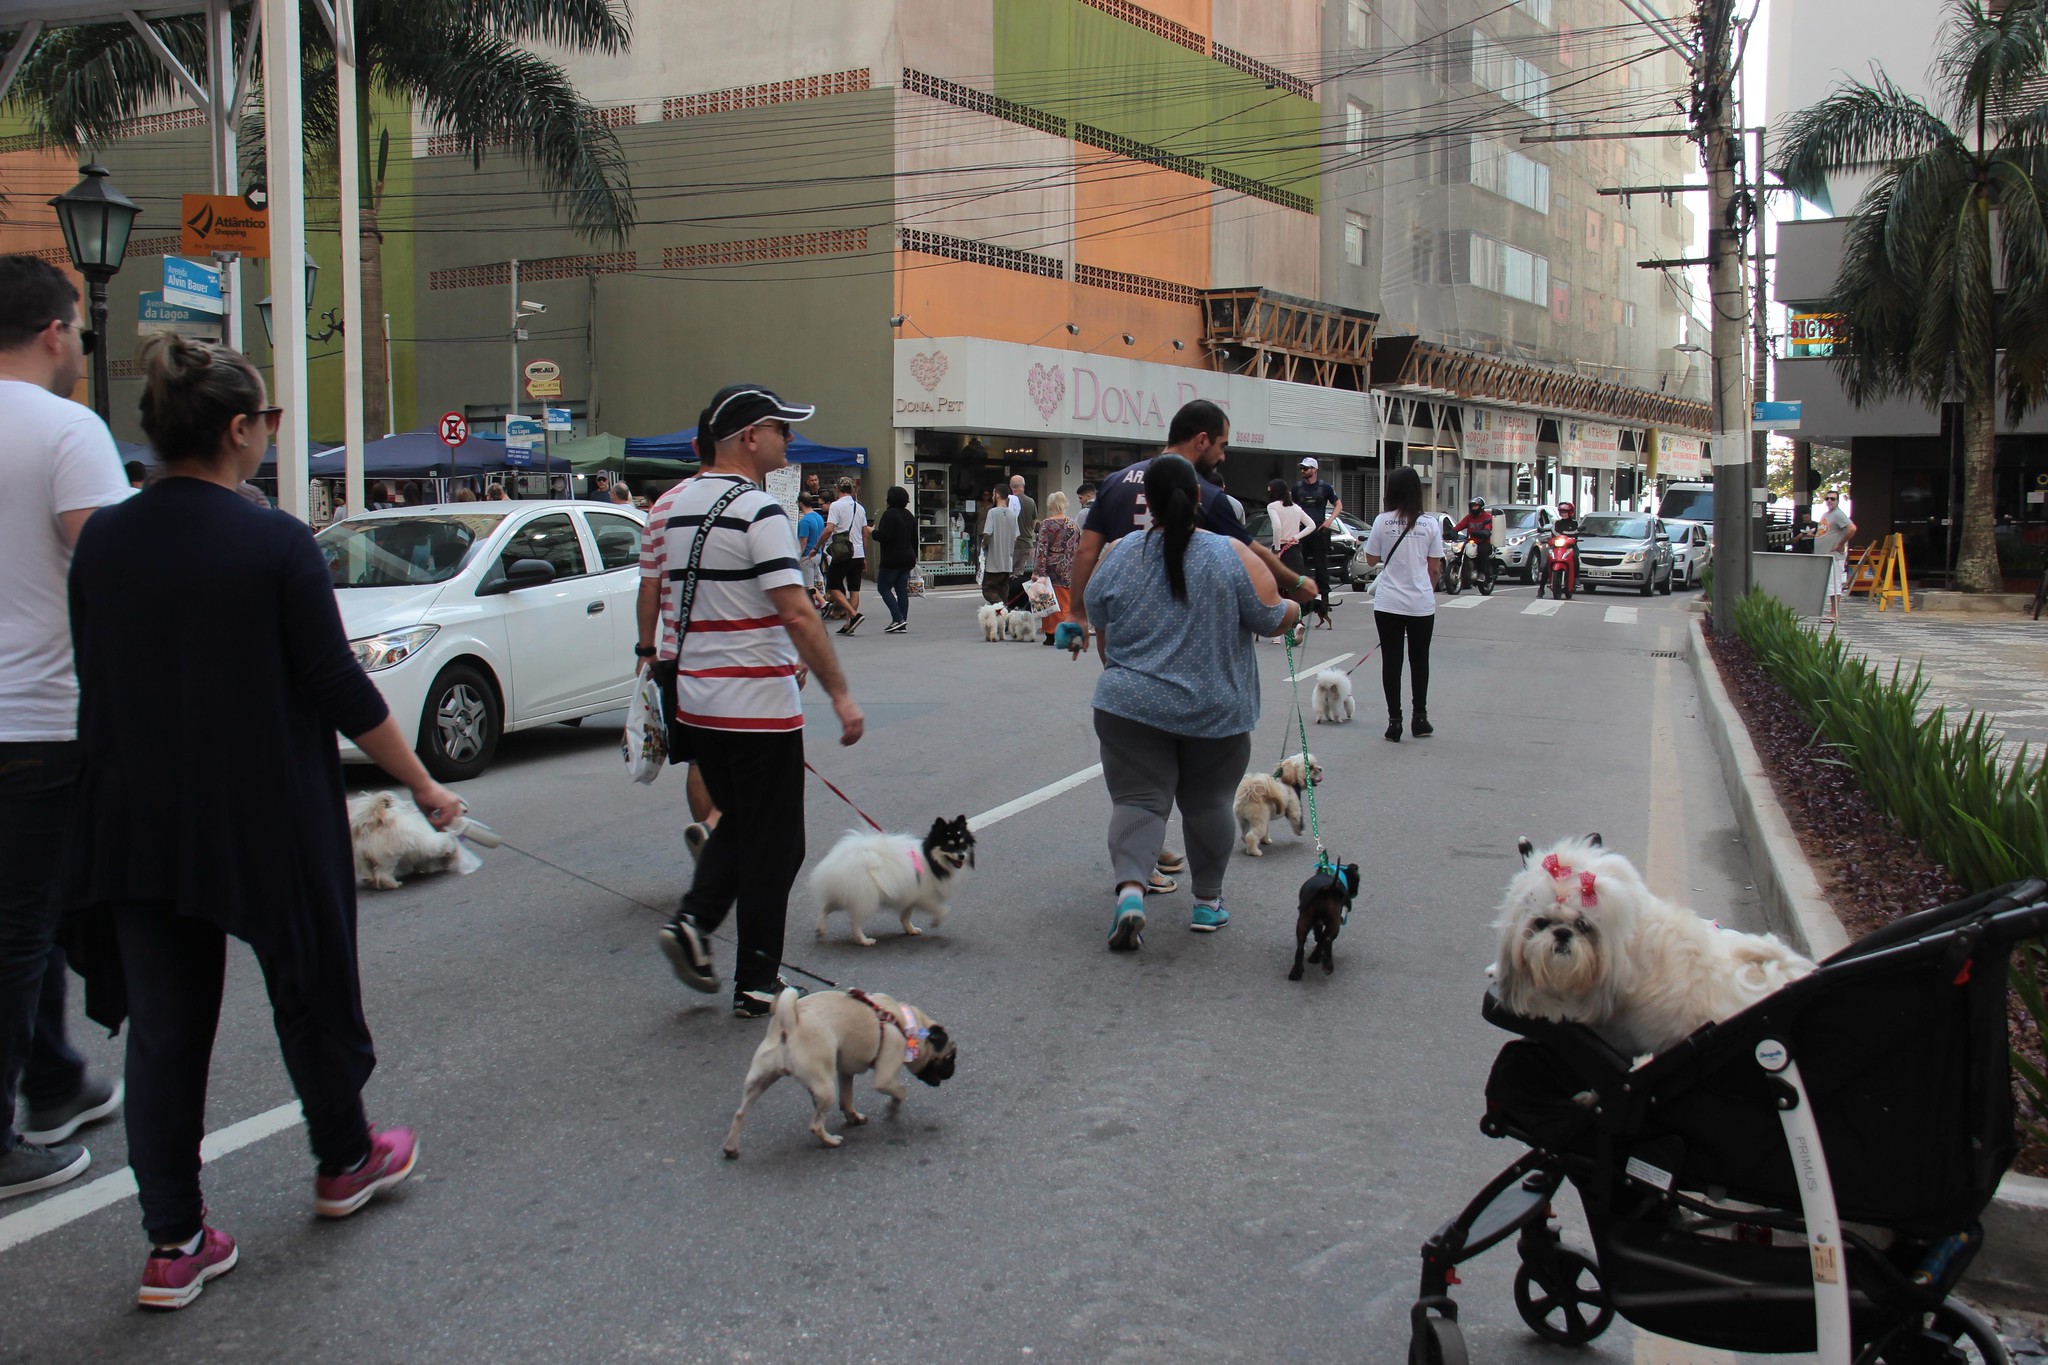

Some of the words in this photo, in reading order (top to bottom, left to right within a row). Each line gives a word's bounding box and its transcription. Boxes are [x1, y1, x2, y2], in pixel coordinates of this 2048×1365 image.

[215, 216, 266, 229] Atlântico
[214, 228, 247, 238] Shopping
[168, 265, 188, 278] Avenida
[168, 274, 187, 288] Alvin
[187, 279, 209, 294] Bauer
[145, 307, 157, 319] da
[160, 308, 189, 322] Lagoa
[1790, 319, 1816, 339] BIG
[896, 398, 934, 413] DONA
[937, 397, 964, 412] PET
[1073, 367, 1166, 428] DONA
[1064, 459, 1071, 475] 6
[700, 499, 728, 532] HUGO
[683, 571, 696, 605] HUGO
[1795, 1136, 1818, 1191] PRIMUS
